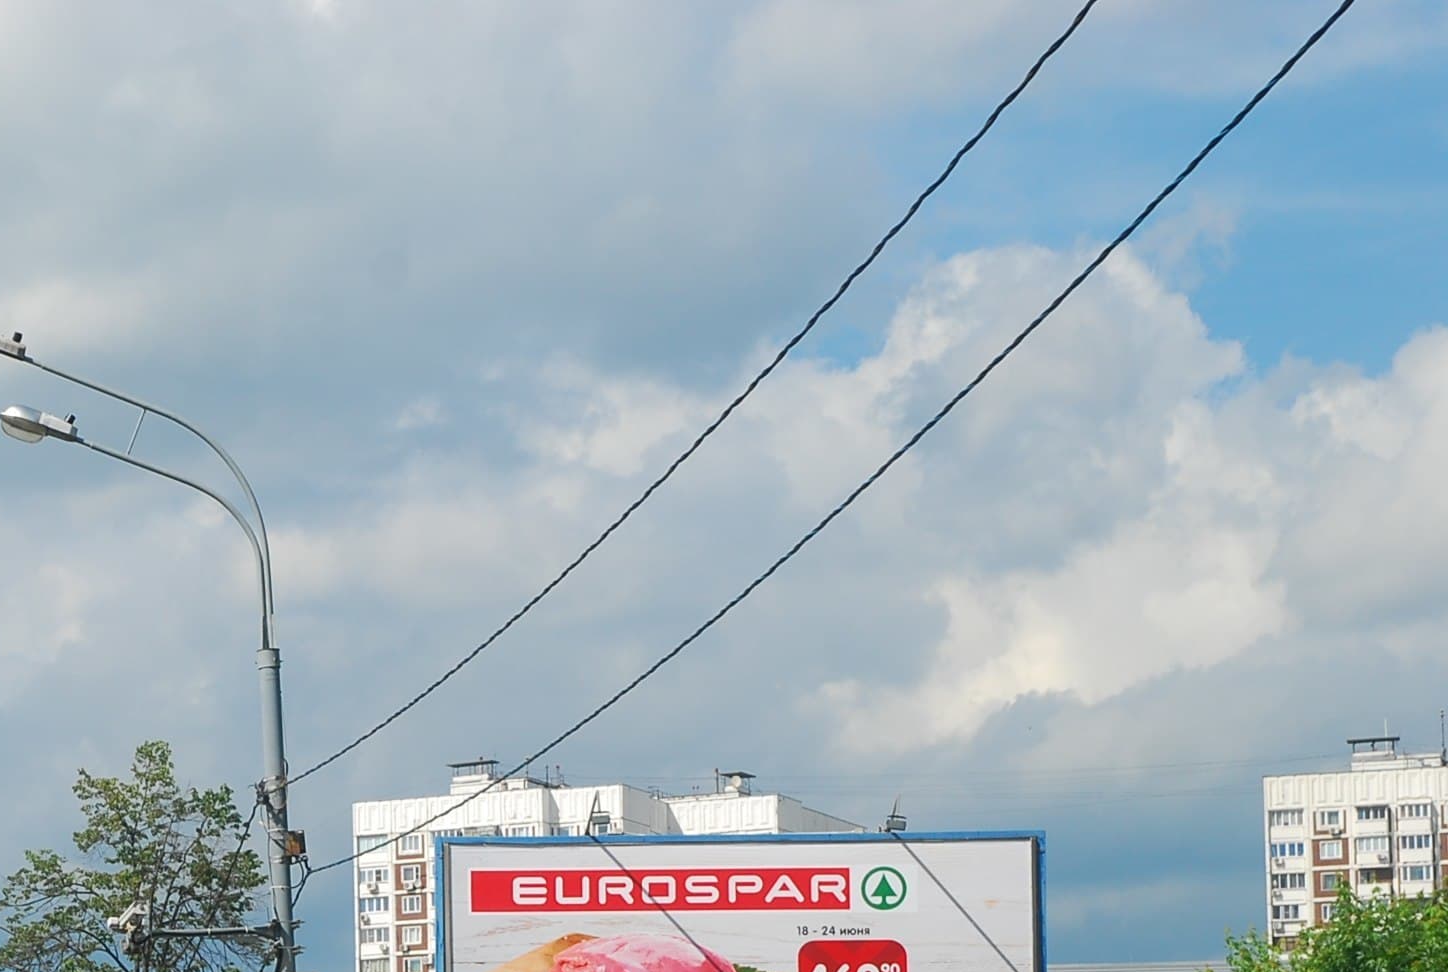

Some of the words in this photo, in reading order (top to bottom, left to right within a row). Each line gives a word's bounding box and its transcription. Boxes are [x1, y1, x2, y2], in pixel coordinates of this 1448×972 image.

[512, 874, 847, 905] EUROSPAR
[796, 925, 809, 936] 18
[821, 925, 836, 936] 24
[840, 927, 871, 936] июня
